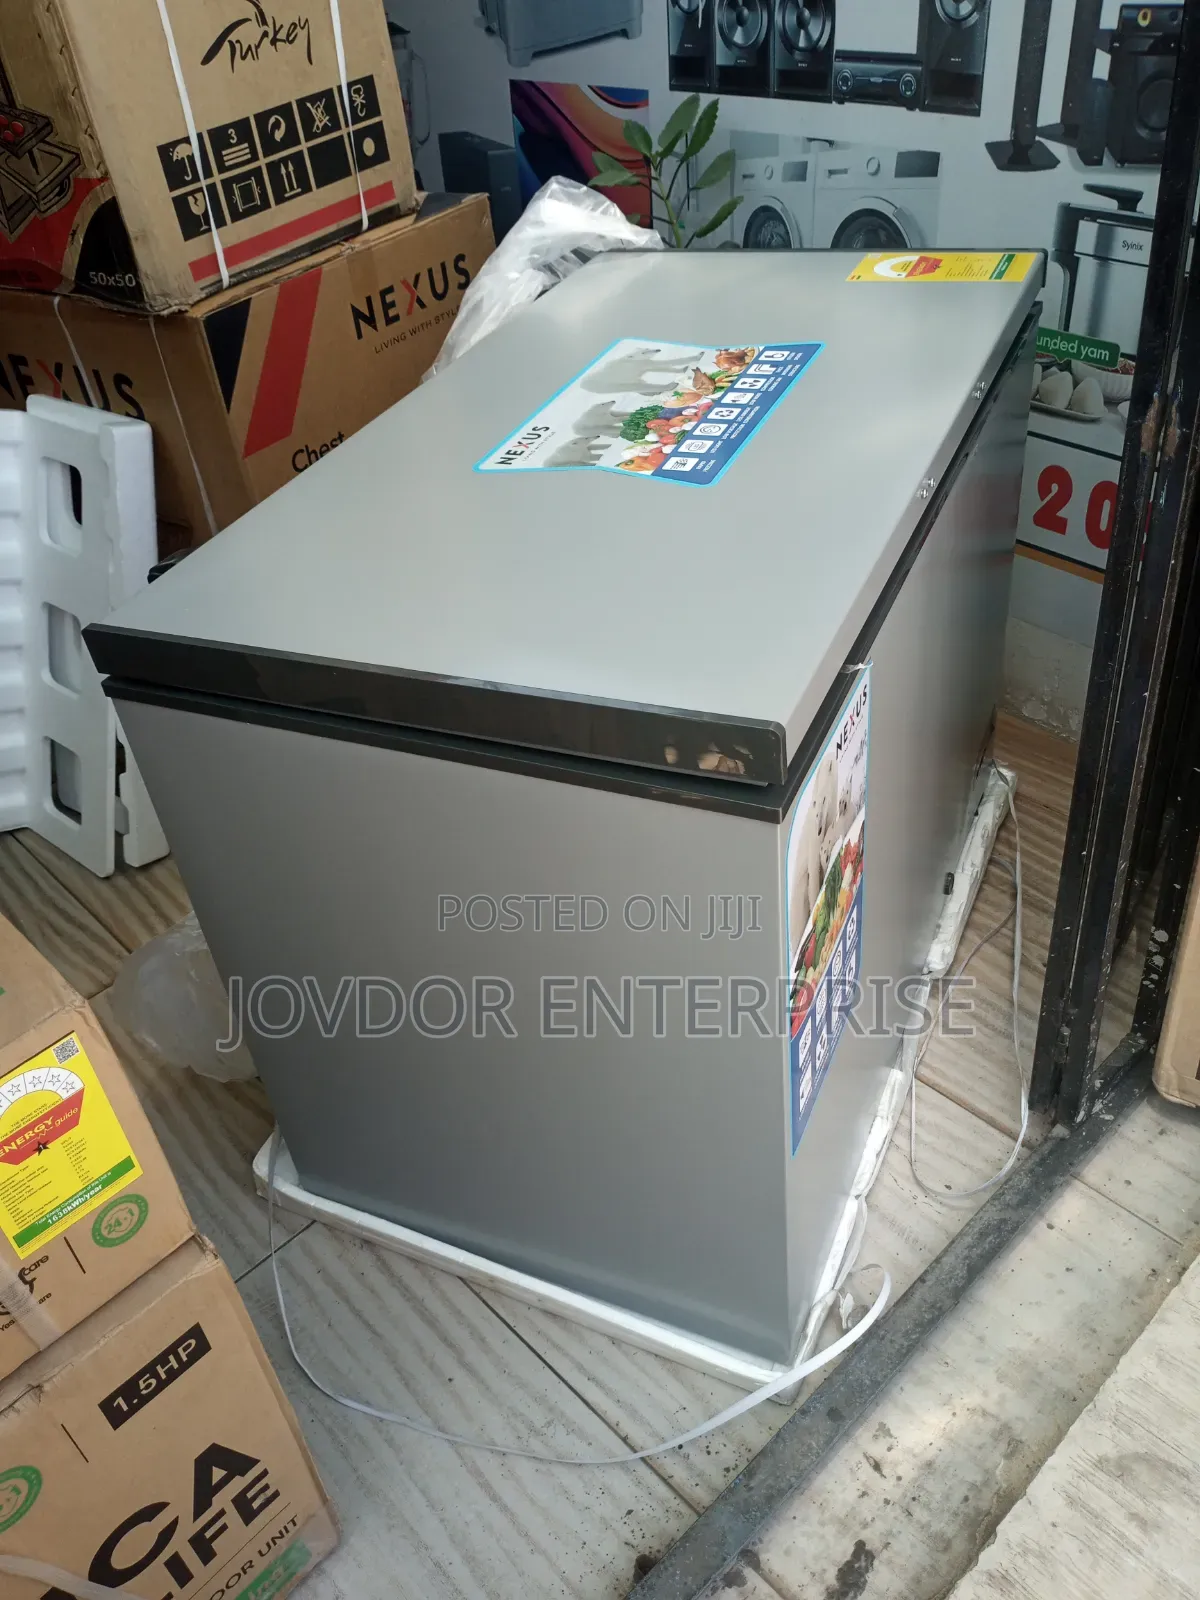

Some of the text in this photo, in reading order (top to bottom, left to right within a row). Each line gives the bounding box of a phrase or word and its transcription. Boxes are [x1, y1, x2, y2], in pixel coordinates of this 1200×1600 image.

[200, 0, 313, 74] Turkey
[227, 128, 238, 144] 3
[89, 271, 136, 287] 50x50
[350, 253, 470, 340] NEXUS
[374, 332, 407, 355] LIVING
[408, 320, 432, 337] WITH
[1080, 345, 1109, 361] yam
[292, 431, 345, 473] Chest
[494, 426, 550, 465] NEXUS
[1033, 465, 1119, 549] 20
[836, 683, 868, 761] NEXUS
[54, 1107, 79, 1127] guide
[113, 1338, 196, 1412] 1.5HP
[40, 1442, 261, 1600] CA
[161, 1468, 281, 1600] IFE
[257, 1514, 298, 1557] UNIT
